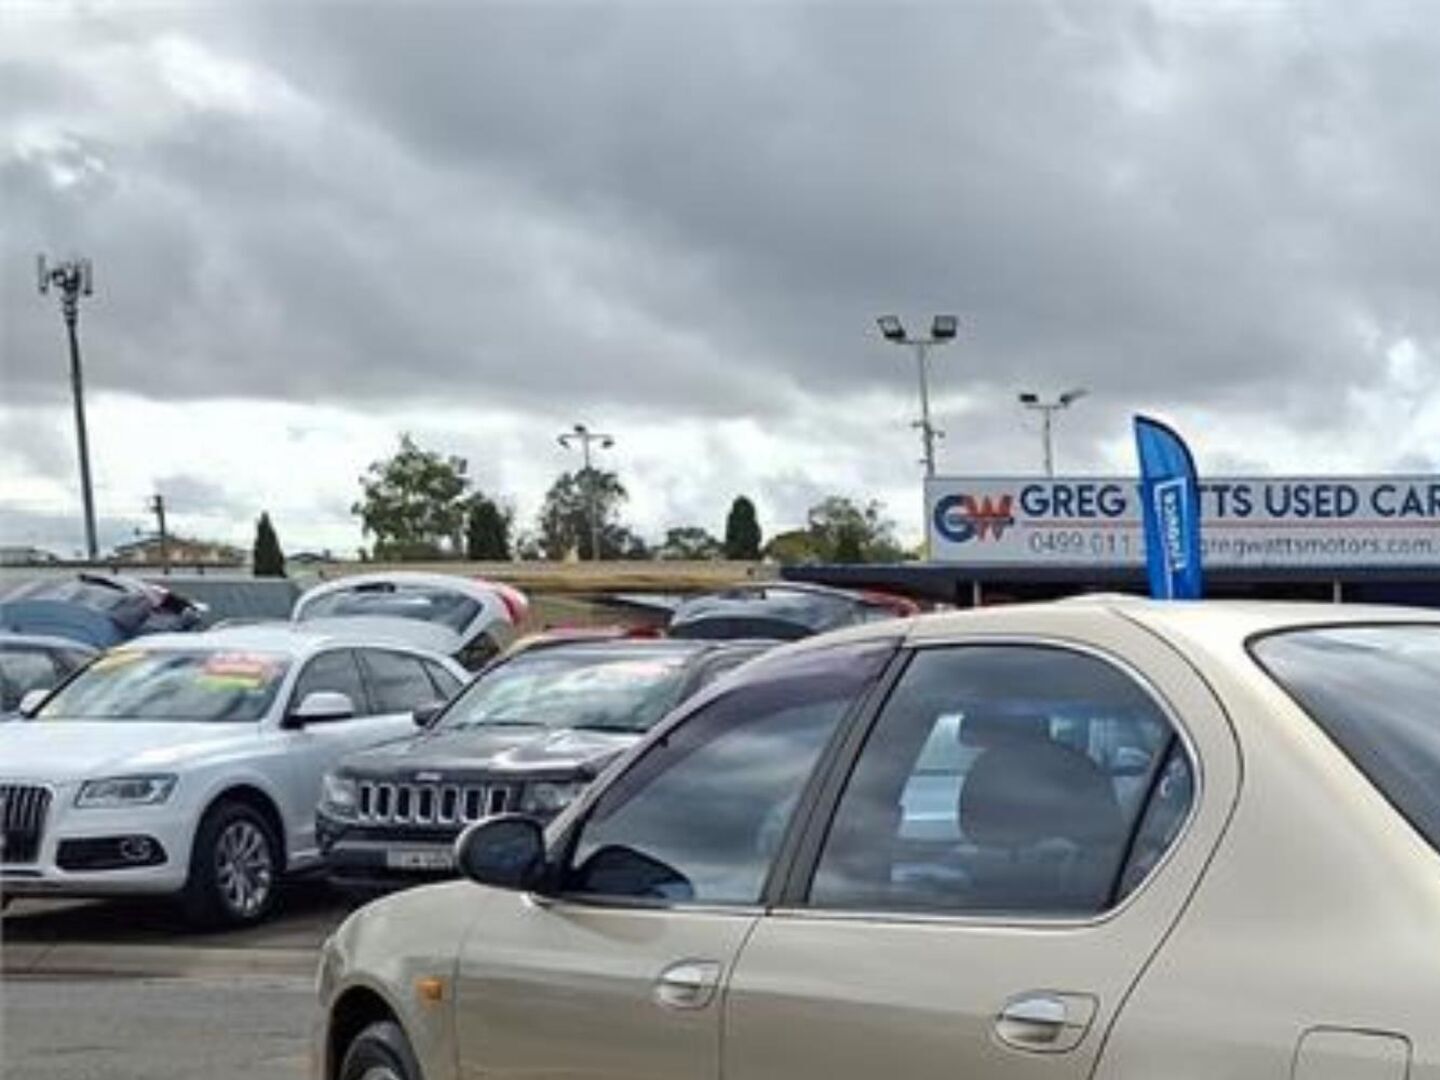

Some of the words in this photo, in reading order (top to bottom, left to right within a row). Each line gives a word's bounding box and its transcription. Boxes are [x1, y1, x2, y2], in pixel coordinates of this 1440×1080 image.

[1020, 484, 1128, 517] GREG
[1264, 484, 1359, 517] USED
[1030, 531, 1084, 553] 0499
[1089, 532, 1130, 554] 011
